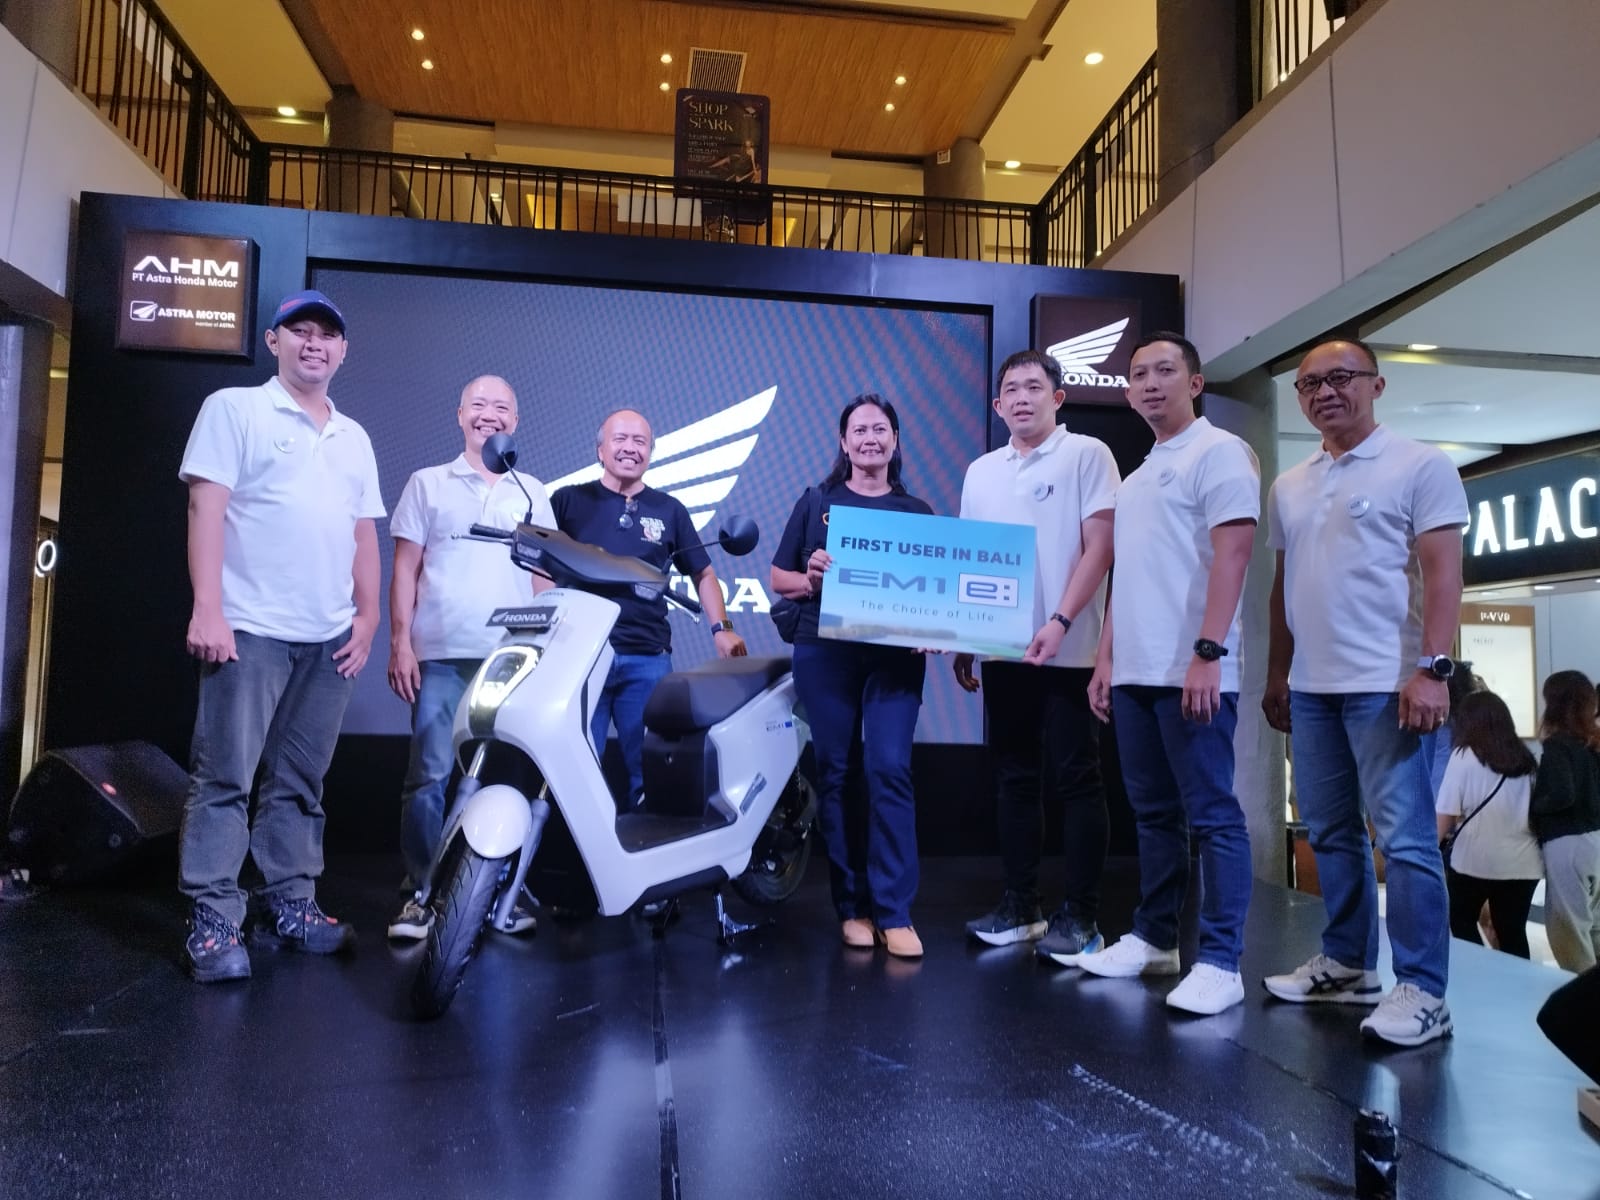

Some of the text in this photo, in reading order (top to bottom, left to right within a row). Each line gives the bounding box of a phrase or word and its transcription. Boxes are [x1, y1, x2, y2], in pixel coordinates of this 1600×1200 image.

[689, 102, 728, 115] SHOP
[689, 116, 734, 132] SPARK
[133, 255, 239, 278] AHM
[132, 272, 237, 288] PT Astra Honda Motor
[158, 307, 236, 322] ASTRA MOTOR
[1061, 372, 1130, 388] ONDA
[1462, 477, 1598, 556] ALAC
[840, 536, 1021, 566] FIRST USER IN BALI
[838, 568, 946, 594] EM1
[504, 613, 547, 623] HONDA
[861, 599, 995, 623] The Choice of Life
